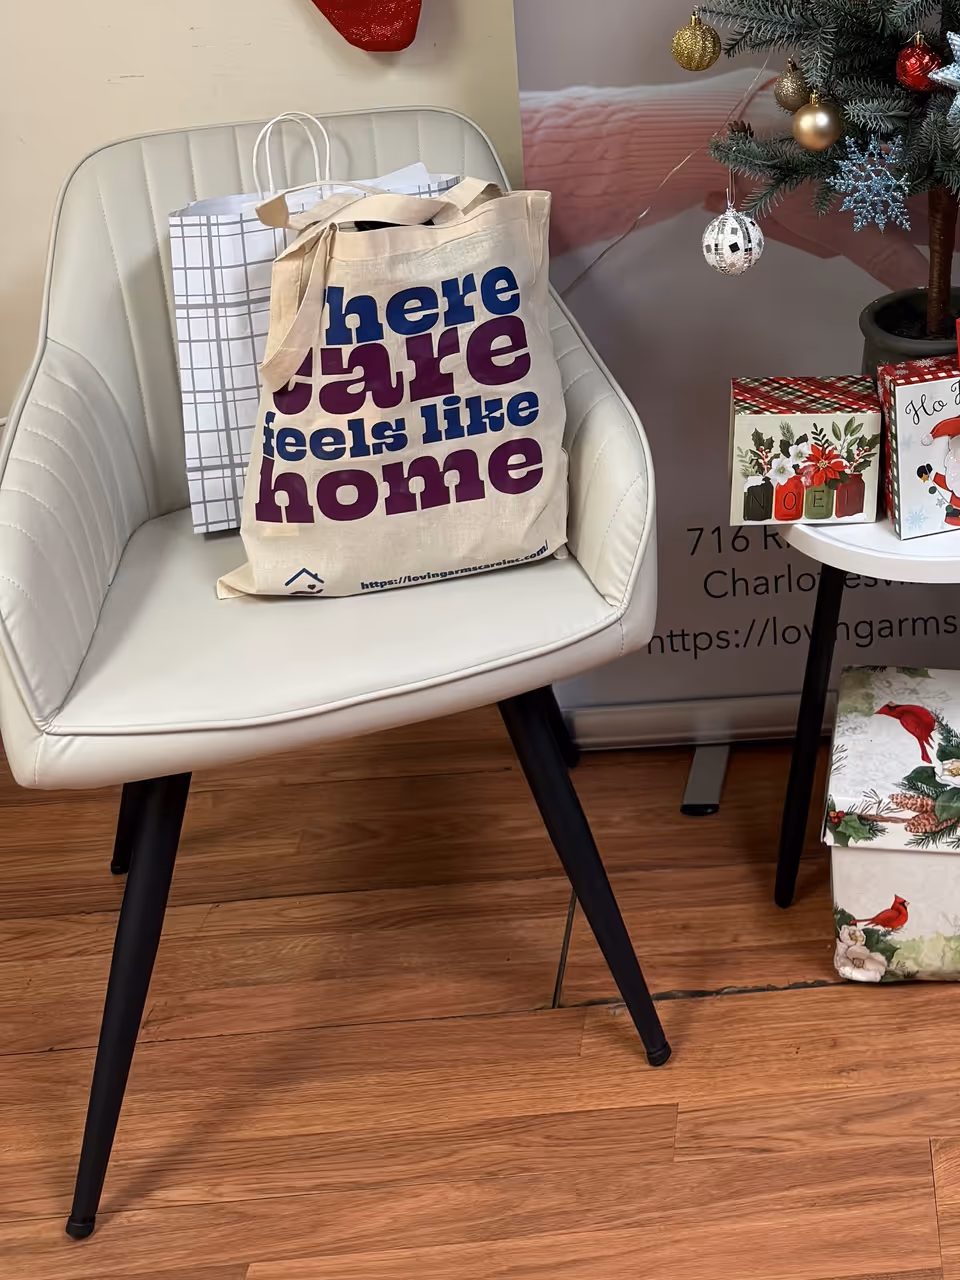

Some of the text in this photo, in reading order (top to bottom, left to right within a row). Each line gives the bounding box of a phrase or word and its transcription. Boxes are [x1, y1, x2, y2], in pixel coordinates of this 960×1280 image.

[322, 266, 520, 346] here
[272, 314, 531, 416] care
[263, 391, 539, 461] feels like
[904, 393, 948, 426] Ho
[255, 437, 544, 524] home
[360, 539, 549, 591] https://lovingarmscareinc.com/
[687, 524, 750, 556] 716
